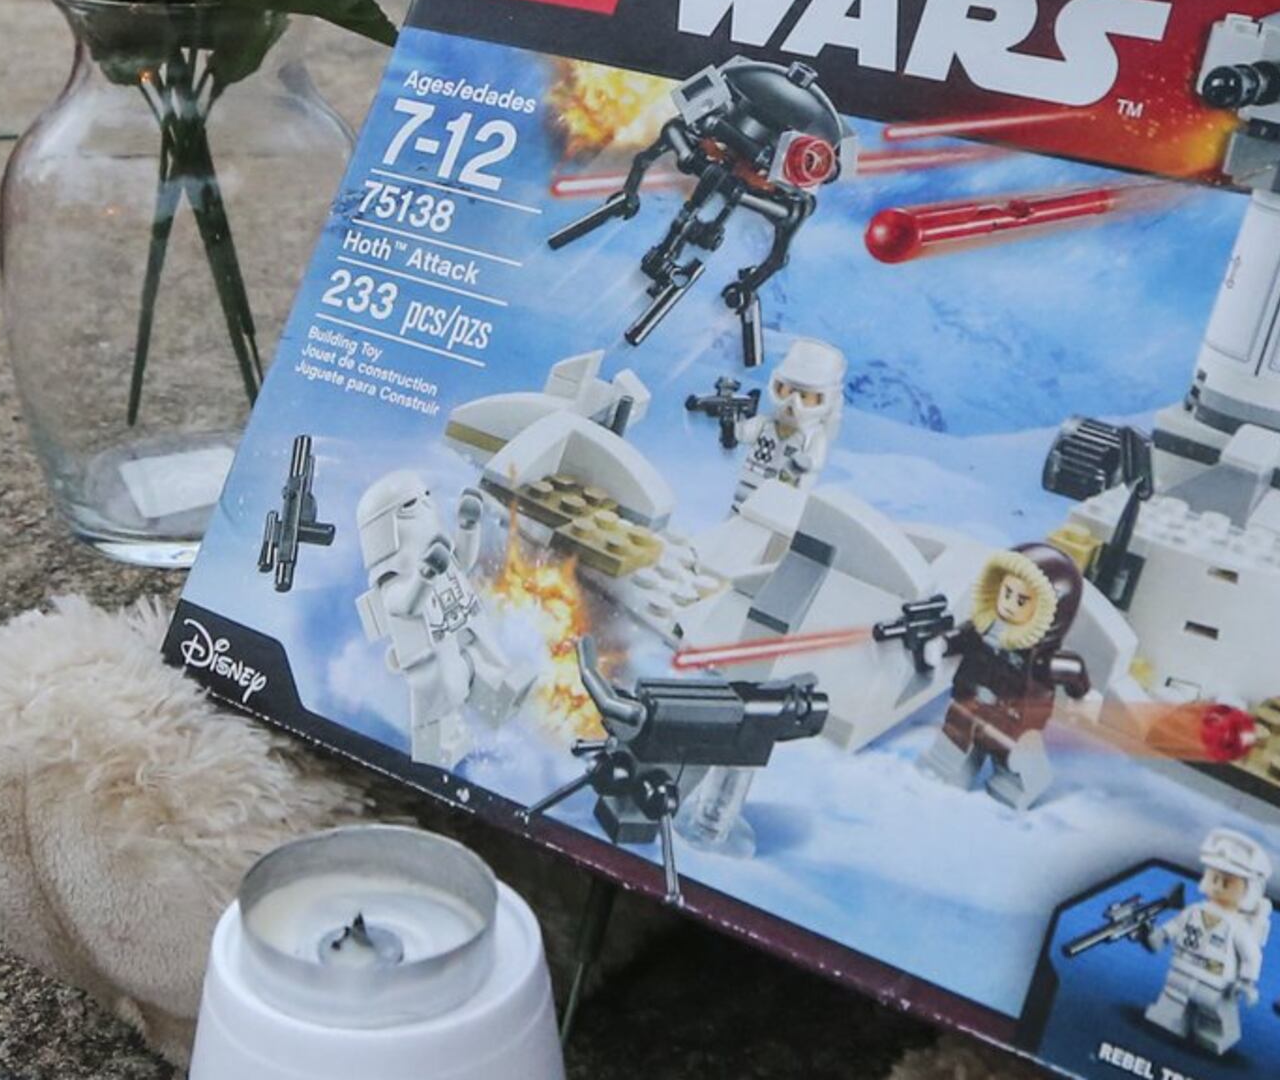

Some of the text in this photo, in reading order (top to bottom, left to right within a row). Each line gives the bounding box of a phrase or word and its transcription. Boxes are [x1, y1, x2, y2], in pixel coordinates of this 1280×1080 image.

[403, 70, 537, 114] Ages/edades
[382, 97, 517, 191] 7-12
[359, 180, 455, 233] 75138
[406, 249, 480, 285] Attack
[322, 269, 492, 350] 233 pcs/pzs
[302, 343, 438, 397] Jouet de construction
[308, 325, 383, 362] Building Toy
[295, 359, 440, 417] Juguete para Construir
[1099, 1042, 1154, 1080] REBEL
